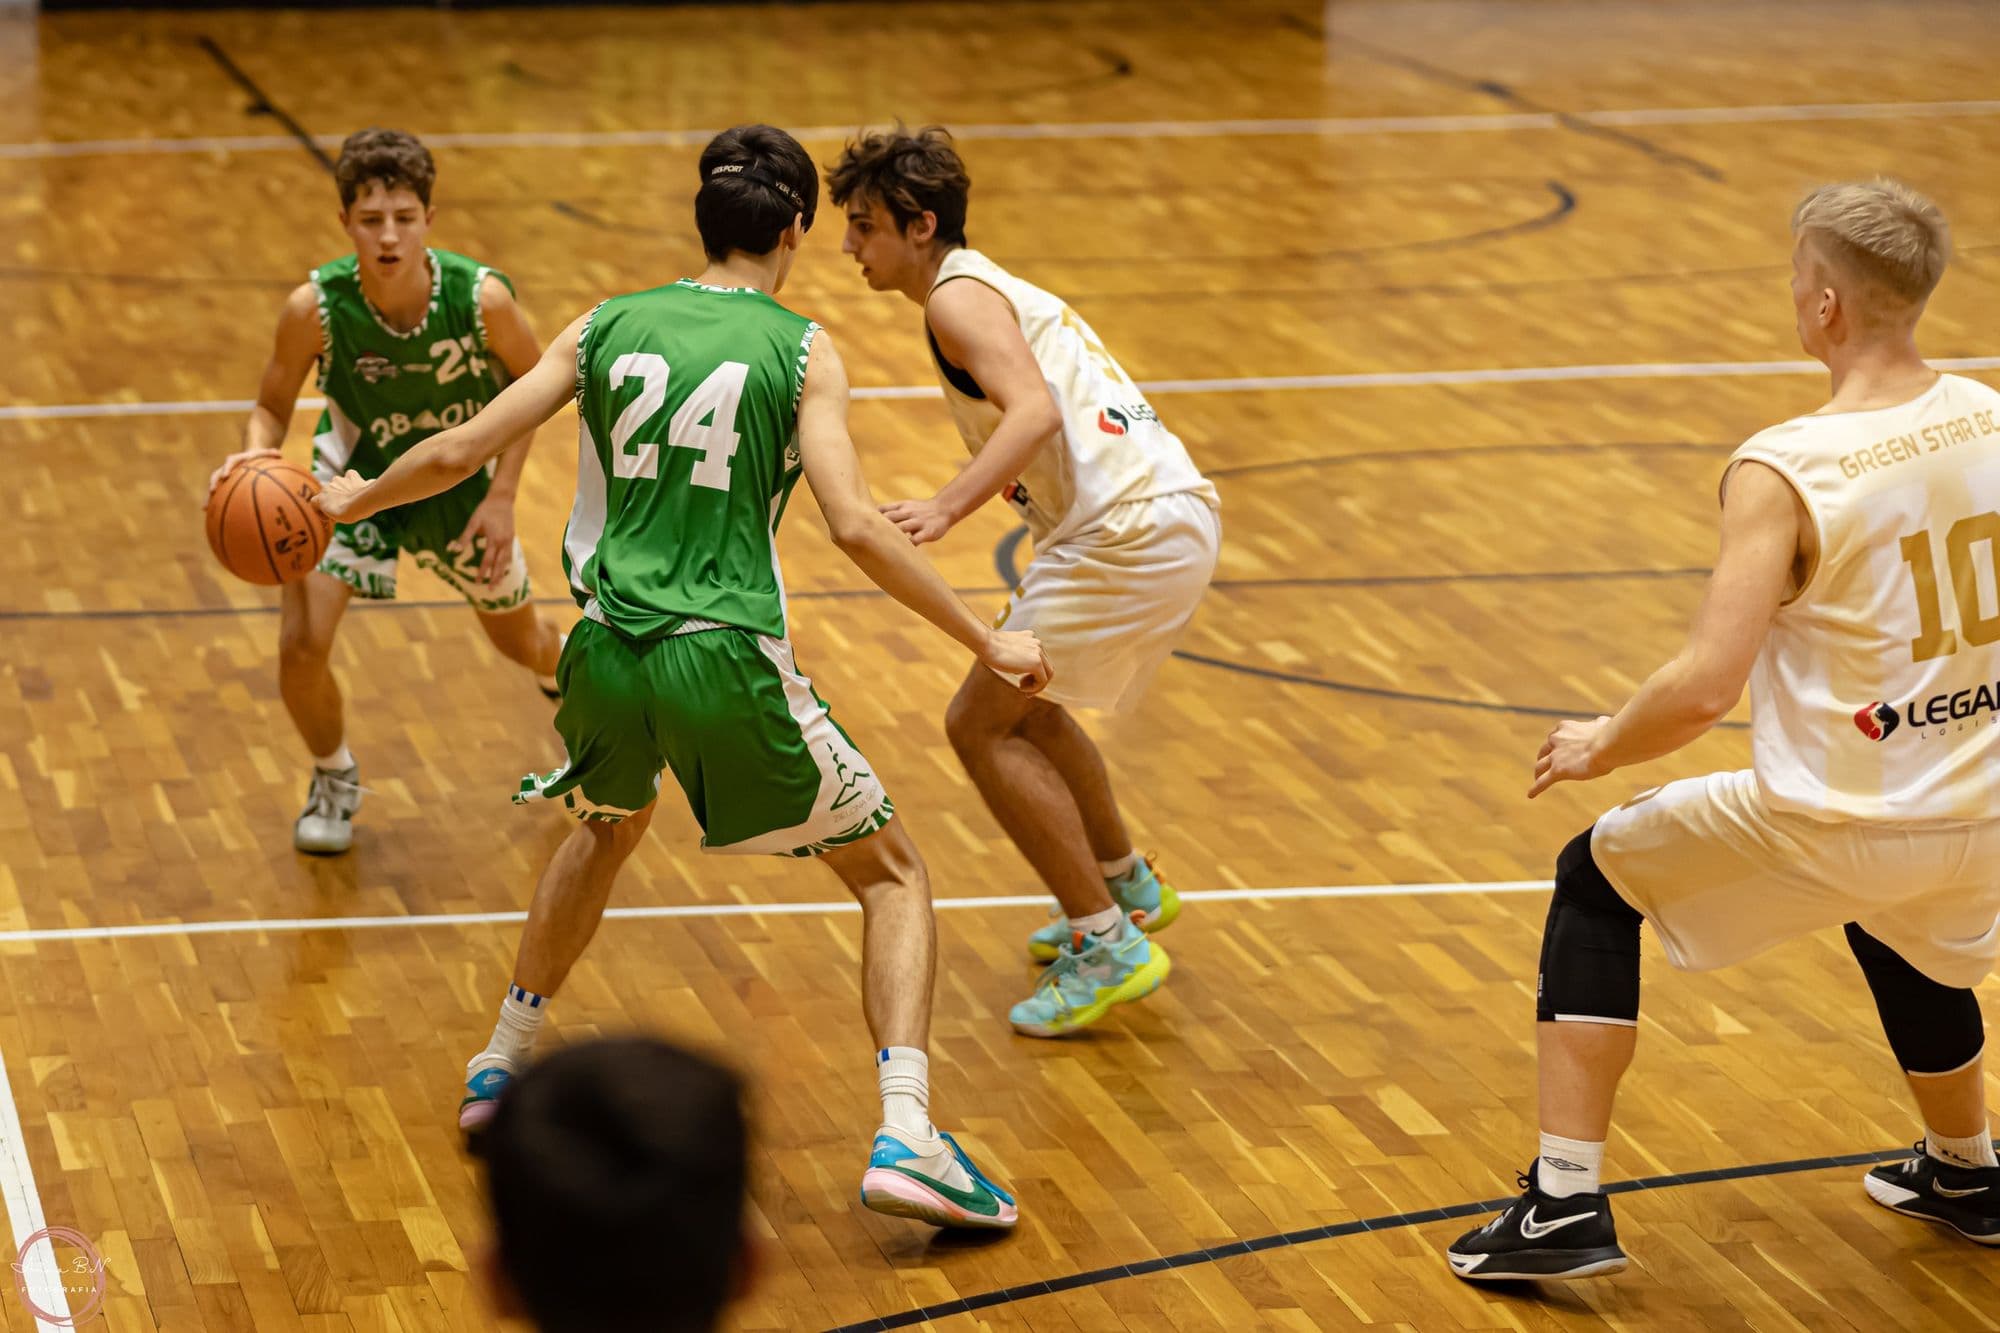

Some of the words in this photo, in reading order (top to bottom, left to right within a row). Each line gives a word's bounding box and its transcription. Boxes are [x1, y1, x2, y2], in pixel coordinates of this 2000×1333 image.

[609, 352, 750, 492] 24
[1839, 434, 1921, 479] GREEN
[1921, 417, 1977, 452] STAR
[1900, 511, 2000, 663] 10
